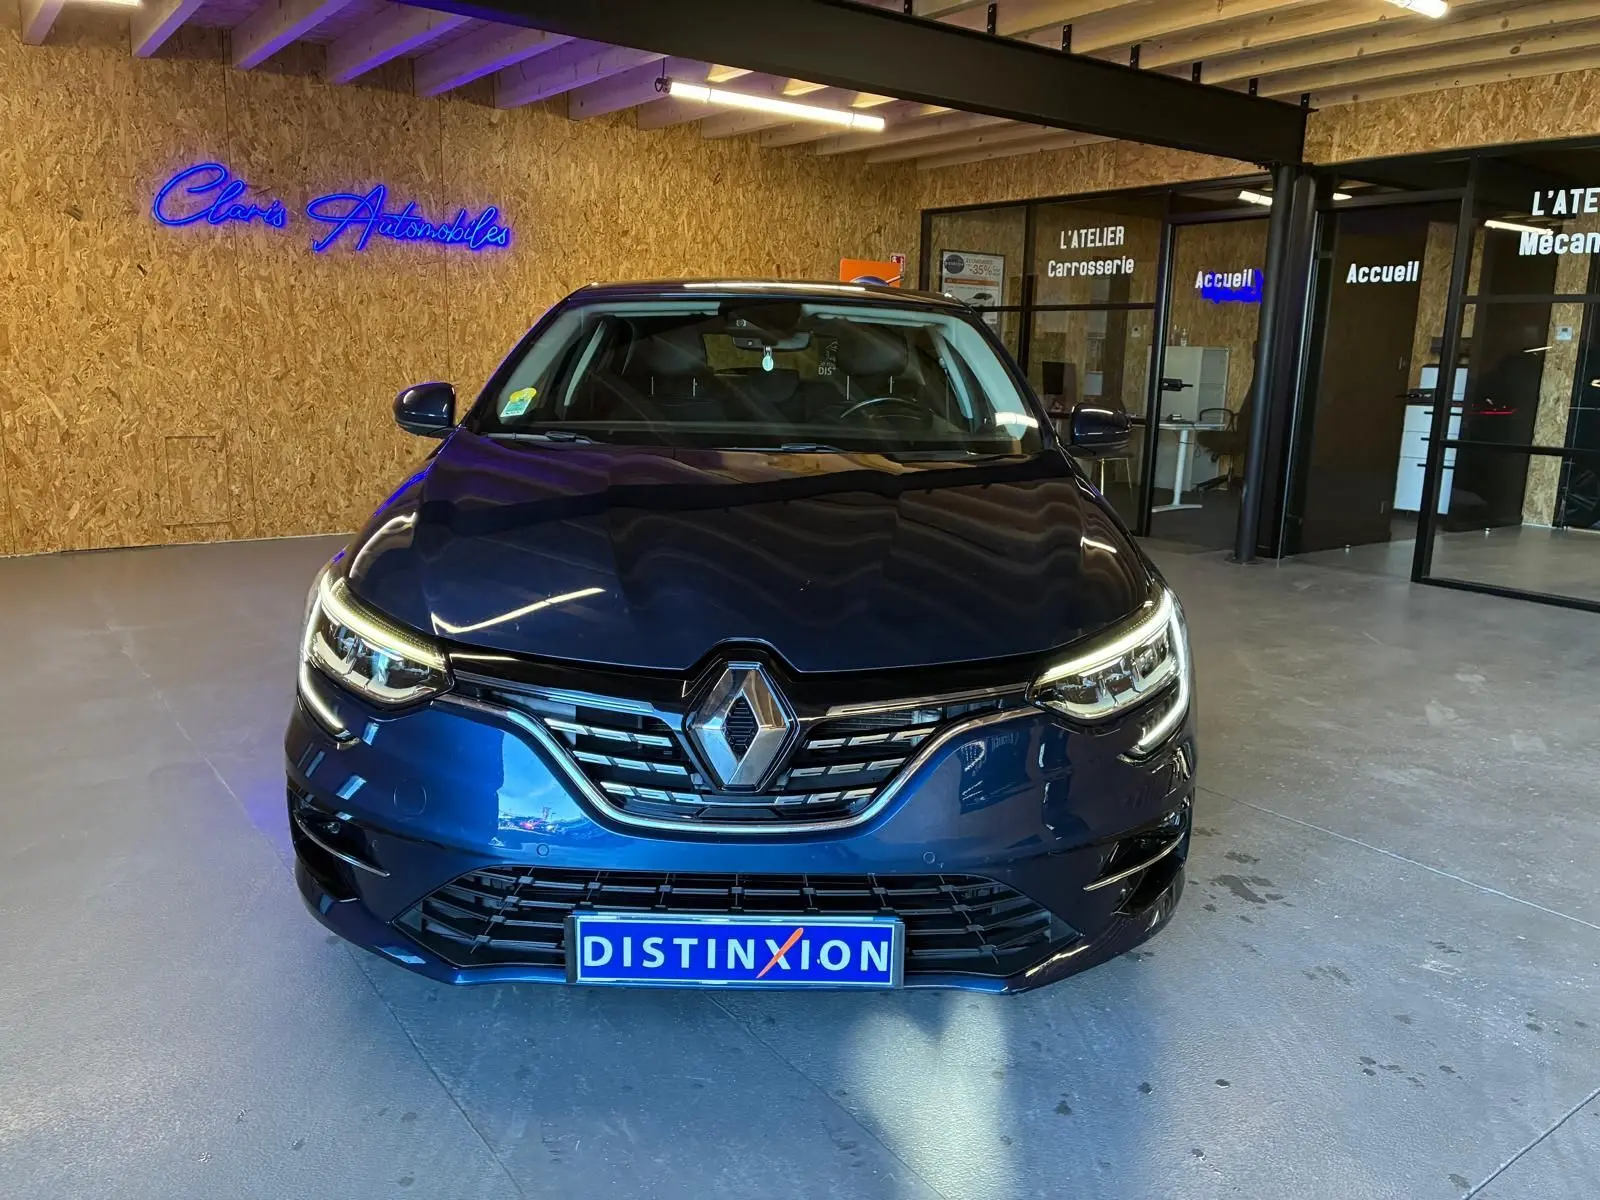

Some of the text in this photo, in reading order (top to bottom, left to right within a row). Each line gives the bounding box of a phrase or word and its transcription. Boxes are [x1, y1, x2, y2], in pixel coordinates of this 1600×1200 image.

[153, 162, 510, 251] Claris Automobiles
[1060, 226, 1125, 249] L'ATELIER
[1047, 255, 1135, 278] Carrosserie
[1345, 260, 1420, 284] Accueil
[1194, 268, 1253, 289] Accueil
[583, 927, 889, 979] DISTINXION
